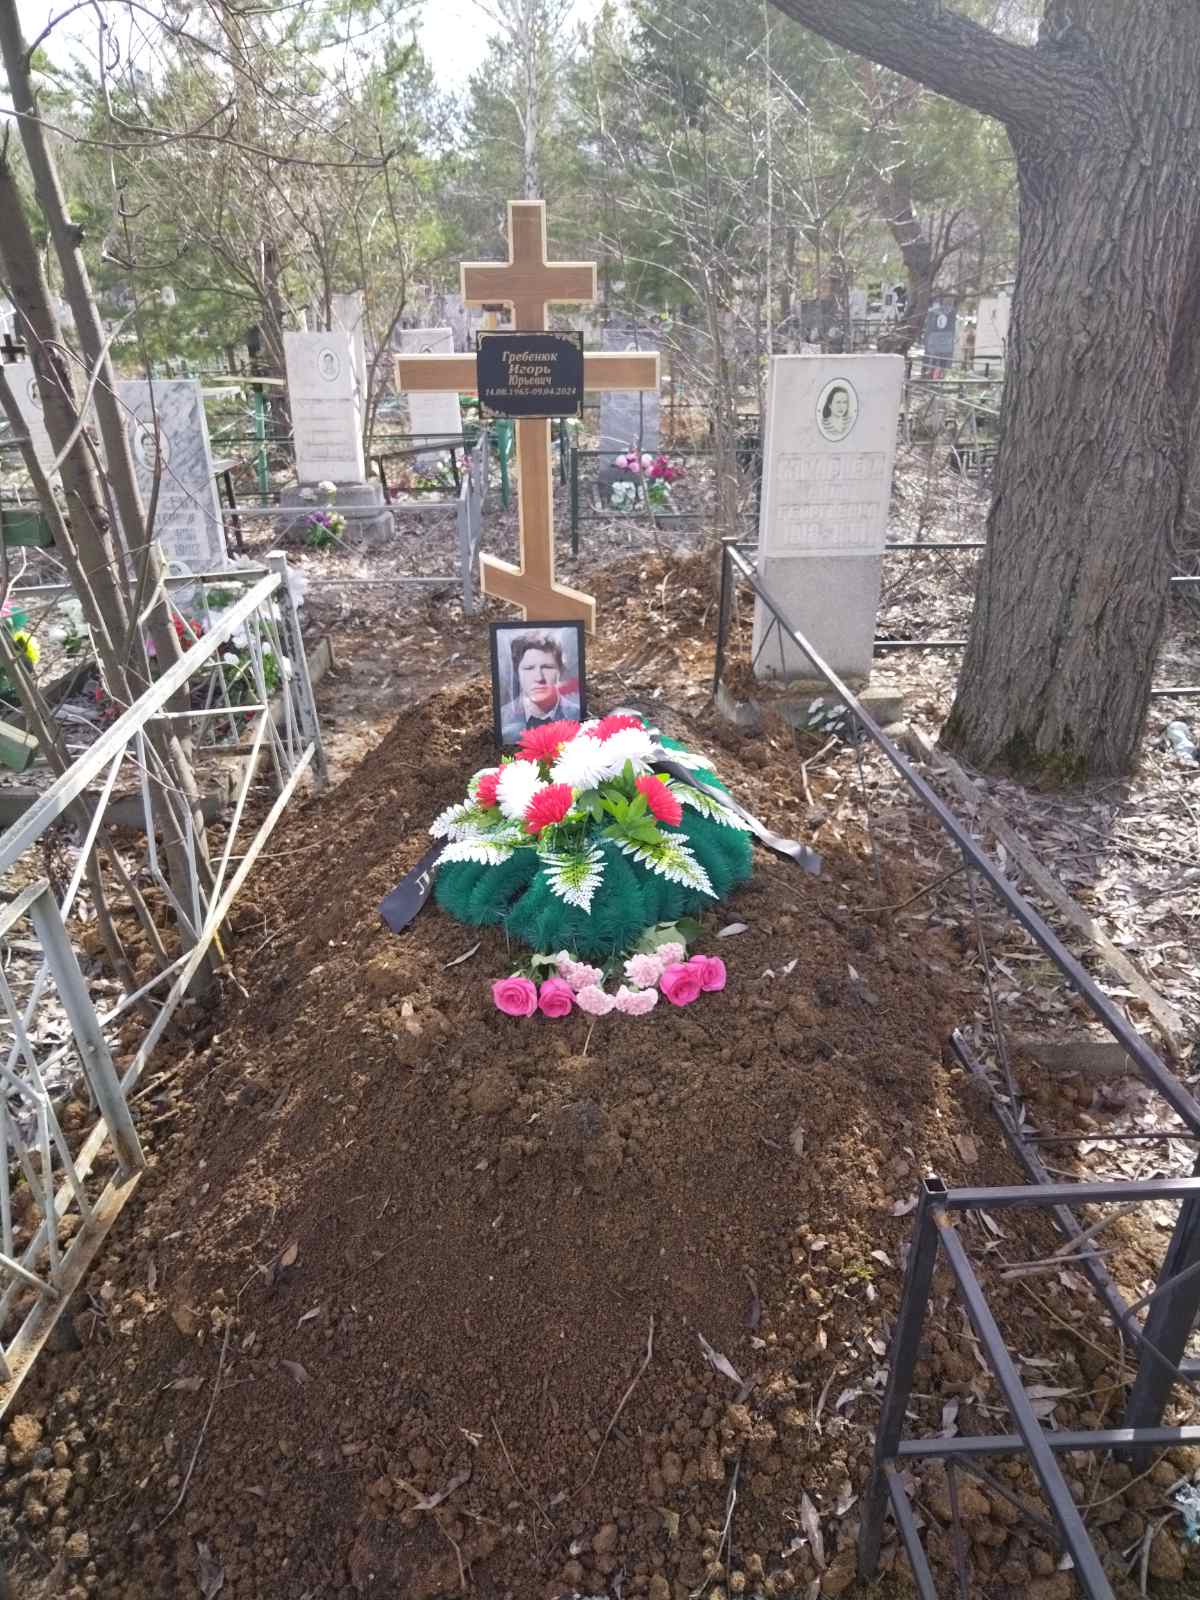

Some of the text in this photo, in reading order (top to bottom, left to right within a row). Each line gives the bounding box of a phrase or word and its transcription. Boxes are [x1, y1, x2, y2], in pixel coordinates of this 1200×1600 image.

[502, 351, 558, 364] Гребенюк
[508, 364, 551, 376] Игорь
[508, 375, 552, 387] Юрьевич
